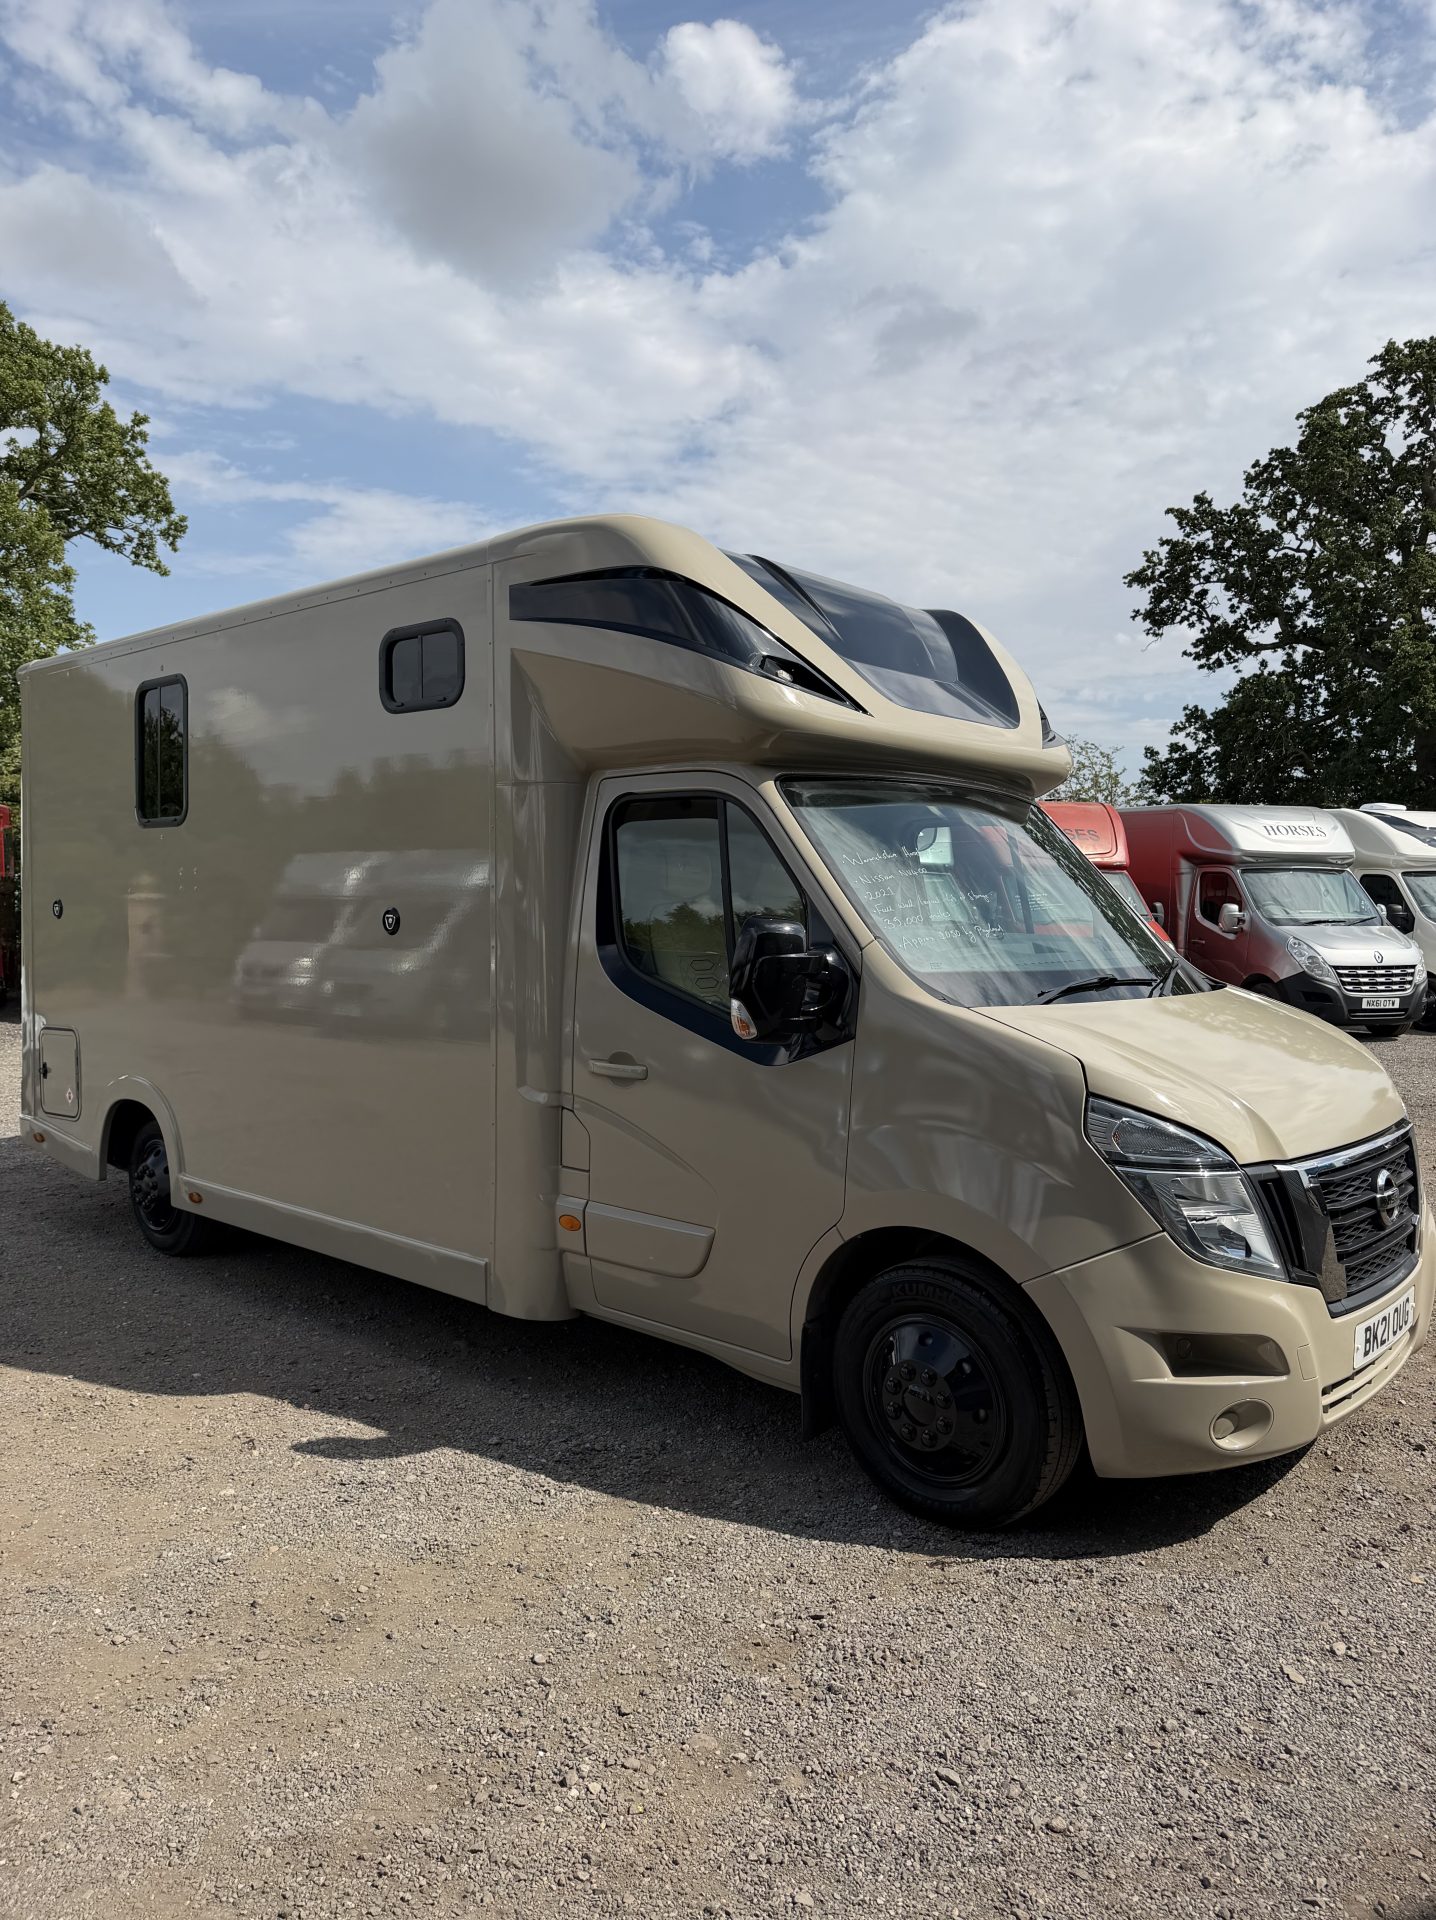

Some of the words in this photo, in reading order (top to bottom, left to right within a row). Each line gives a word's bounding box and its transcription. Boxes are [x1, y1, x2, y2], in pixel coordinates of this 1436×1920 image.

[1063, 828, 1101, 841] SES
[1263, 825, 1327, 837] HORSES
[866, 886, 894, 901] 2021
[1366, 999, 1381, 1007] NX61
[1363, 1312, 1390, 1357] BK21
[1392, 1296, 1410, 1337] OUG
